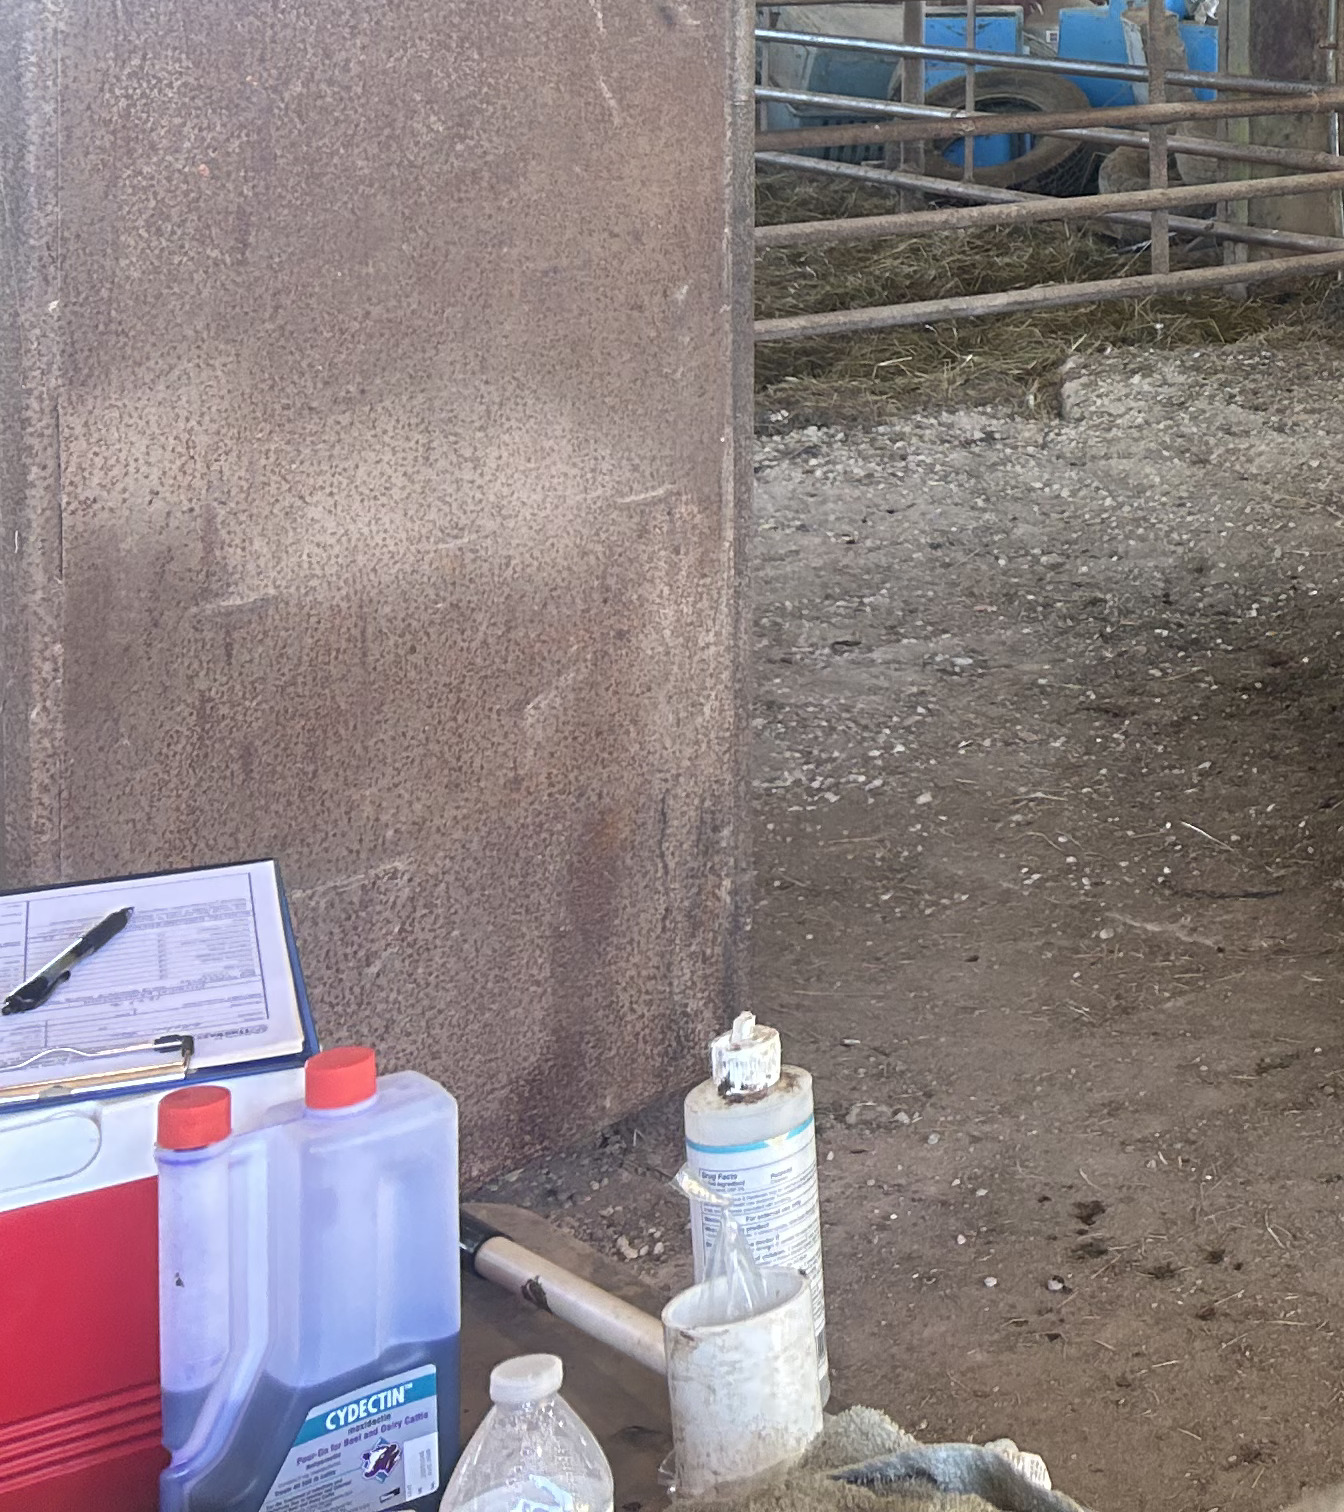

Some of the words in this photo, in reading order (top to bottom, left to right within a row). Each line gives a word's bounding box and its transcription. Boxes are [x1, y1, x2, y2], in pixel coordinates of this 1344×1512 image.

[702, 1172, 716, 1181] Drug
[348, 1413, 392, 1435] moxidectin
[297, 1447, 329, 1466] Pour-On
[330, 1442, 341, 1452] for
[343, 1433, 361, 1447] Beef
[363, 1427, 379, 1440] and
[381, 1419, 403, 1434] Dairy
[404, 1411, 429, 1426] Cattle
